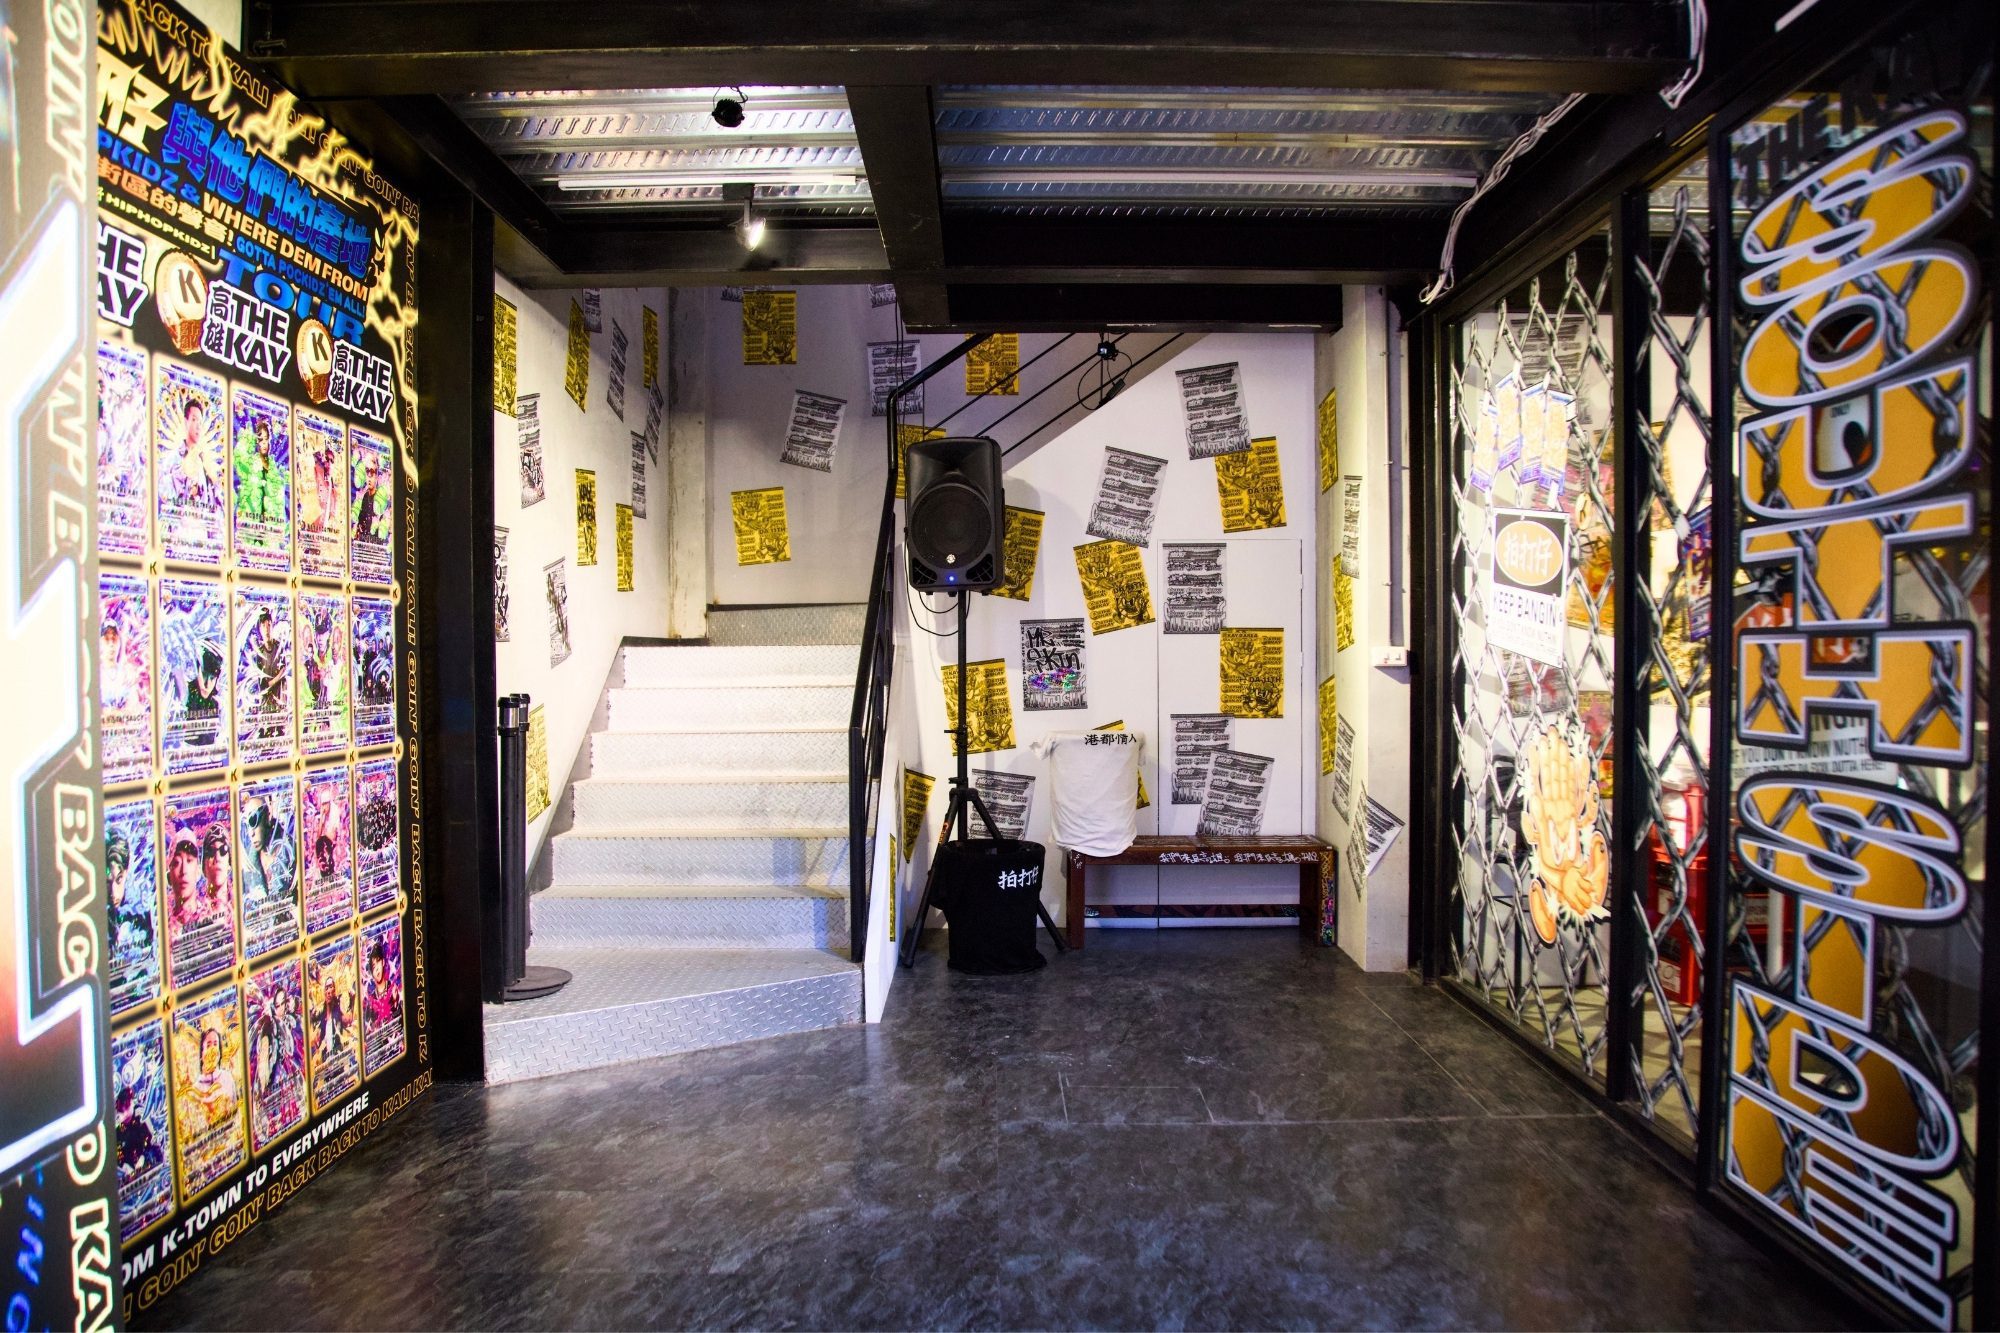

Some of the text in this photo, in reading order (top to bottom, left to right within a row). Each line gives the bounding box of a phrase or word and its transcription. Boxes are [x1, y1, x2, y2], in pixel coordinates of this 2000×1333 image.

[133, 0, 188, 48] ACK
[224, 55, 269, 108] KALI
[46, 0, 87, 200] OIN'
[162, 102, 373, 281] 與他們的產地
[98, 233, 142, 282] HE
[203, 193, 279, 250] WHERE
[280, 239, 321, 275] DEM
[323, 262, 370, 301] FROM
[236, 236, 276, 270] GOTTA
[98, 273, 144, 321] AY
[177, 268, 202, 304] K
[204, 285, 231, 354] 高雄
[219, 248, 366, 346] TOUR
[231, 290, 289, 347] THE
[224, 327, 290, 378] KAY
[311, 332, 329, 362] K
[405, 282, 416, 368] BCK
[330, 343, 349, 401] 高雄
[344, 378, 393, 419] KAY
[348, 348, 392, 389] THE
[405, 497, 416, 565] KALI
[407, 650, 418, 734] GOIN'
[1084, 733, 1137, 746] 港都情人
[408, 737, 421, 819] GOIN'
[411, 823, 422, 904] BACK
[998, 865, 1039, 890] 拍打仔
[414, 909, 425, 989] BACK
[416, 991, 427, 1029] TO
[138, 1237, 207, 1311] GOIN'
[210, 1192, 267, 1255] GOIN'
[267, 1159, 316, 1211] BACK
[318, 1125, 362, 1174] BACK
[362, 1108, 382, 1136] TO
[381, 1089, 412, 1126] KALI
[161, 1181, 242, 1260] K-TOWN
[246, 1164, 269, 1194] TO
[272, 1091, 370, 1178] EVERYWHERE
